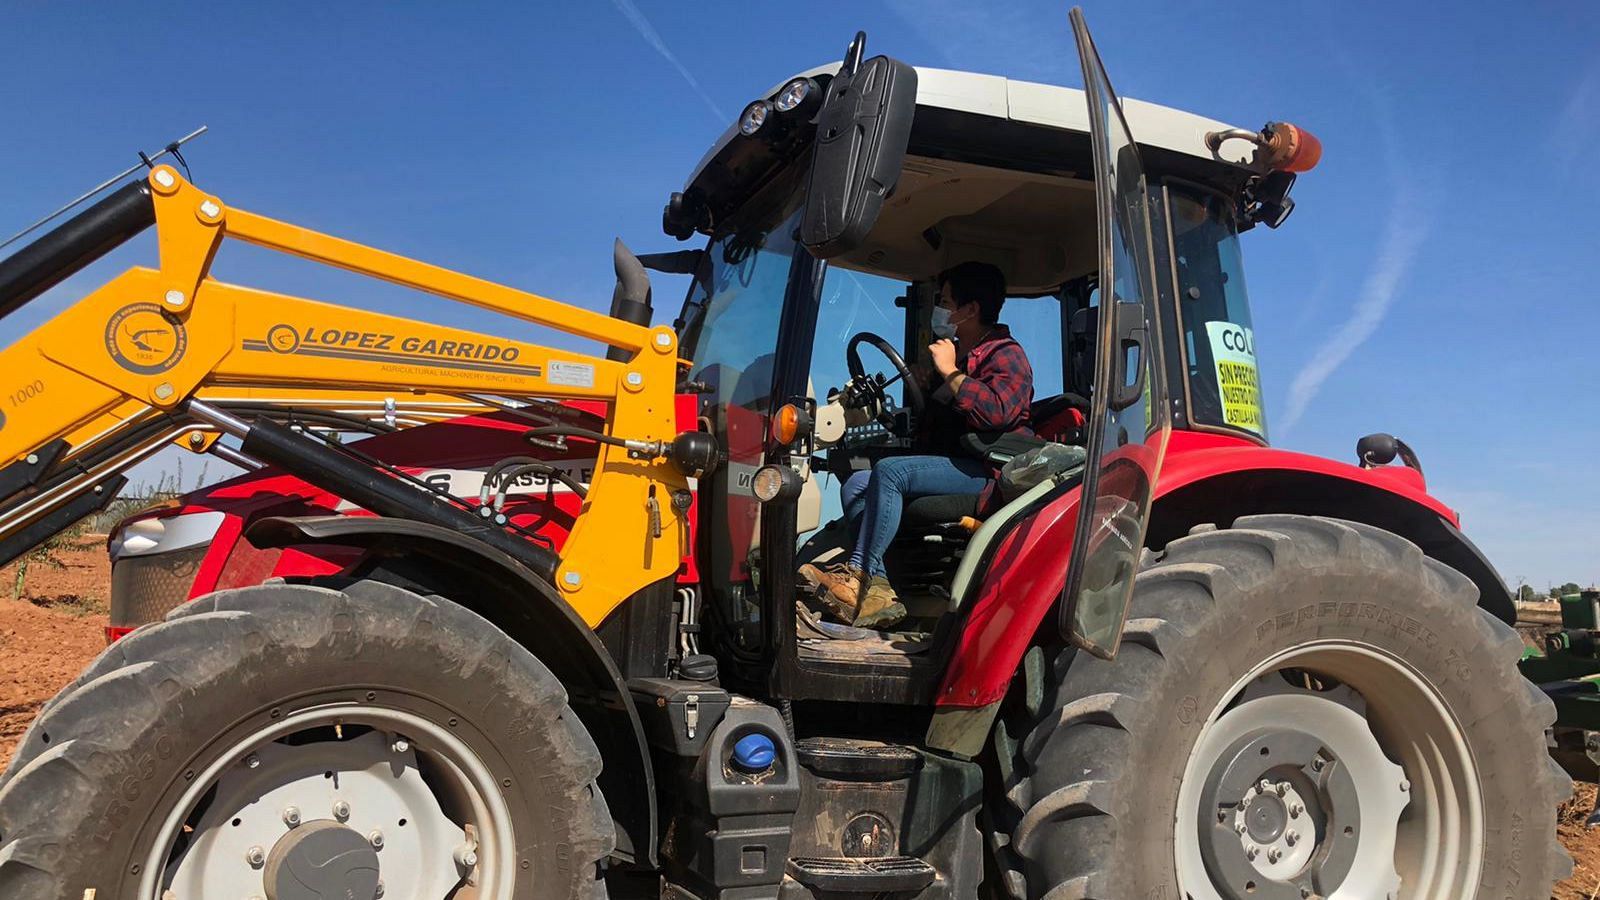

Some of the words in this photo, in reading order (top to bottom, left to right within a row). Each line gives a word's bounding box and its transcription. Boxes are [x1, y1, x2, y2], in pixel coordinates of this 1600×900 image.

[303, 327, 395, 350] LOPEZ
[401, 336, 520, 362] GARRIDO
[381, 364, 437, 377] AGRICULTURAL
[440, 370, 484, 381] MACHINERY
[9, 379, 44, 407] 1000
